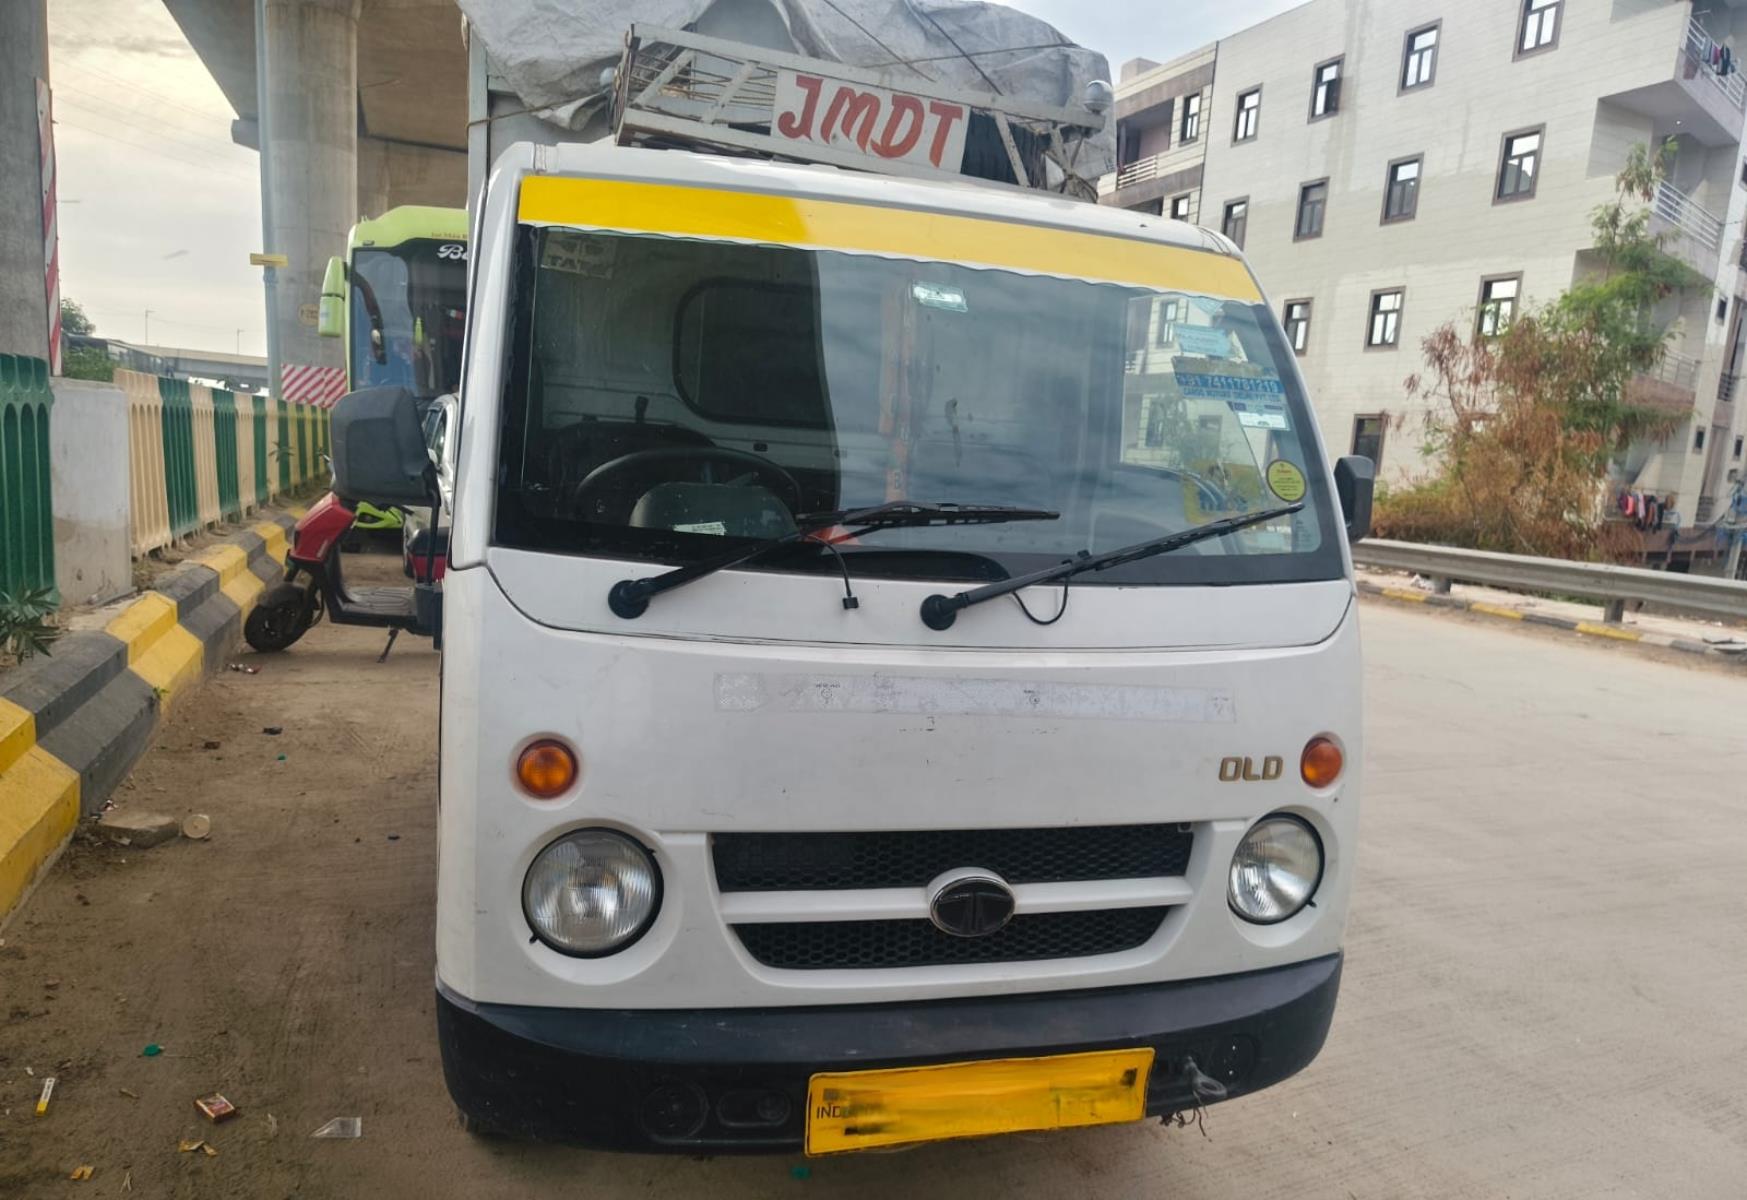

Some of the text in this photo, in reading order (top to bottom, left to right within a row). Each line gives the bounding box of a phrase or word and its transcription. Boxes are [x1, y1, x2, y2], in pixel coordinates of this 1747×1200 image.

[777, 74, 964, 168] JMDT
[1218, 755, 1283, 782] OLD
[816, 1104, 842, 1119] IND
